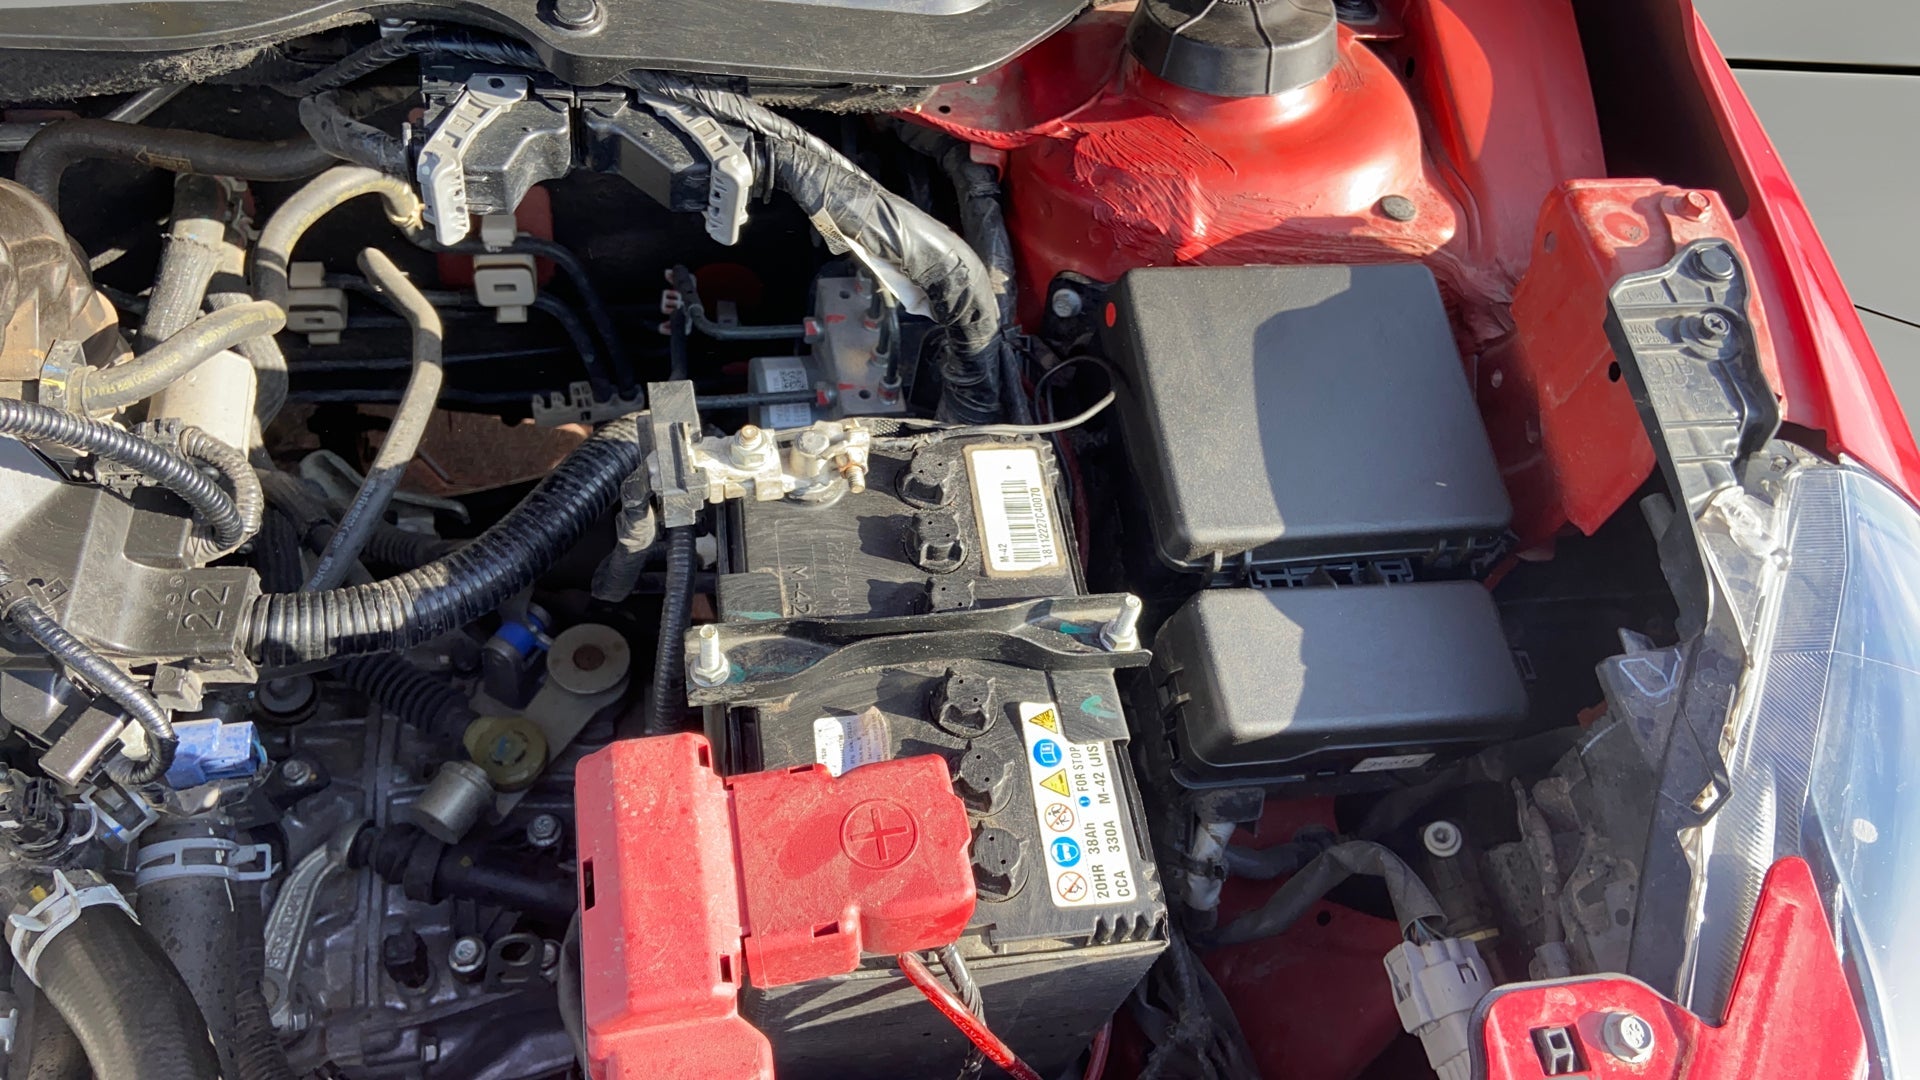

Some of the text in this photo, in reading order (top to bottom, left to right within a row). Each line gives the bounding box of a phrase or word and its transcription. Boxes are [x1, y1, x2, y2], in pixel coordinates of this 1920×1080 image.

[1030, 487, 1053, 559] 18112227C40070
[998, 543, 1010, 563] M-42
[182, 586, 230, 630] 22
[1093, 771, 1111, 805] M-42
[1069, 746, 1110, 899] 20HR 38Ah FOR STOP
[1104, 820, 1121, 853] 330A
[1115, 870, 1131, 898] CCA
